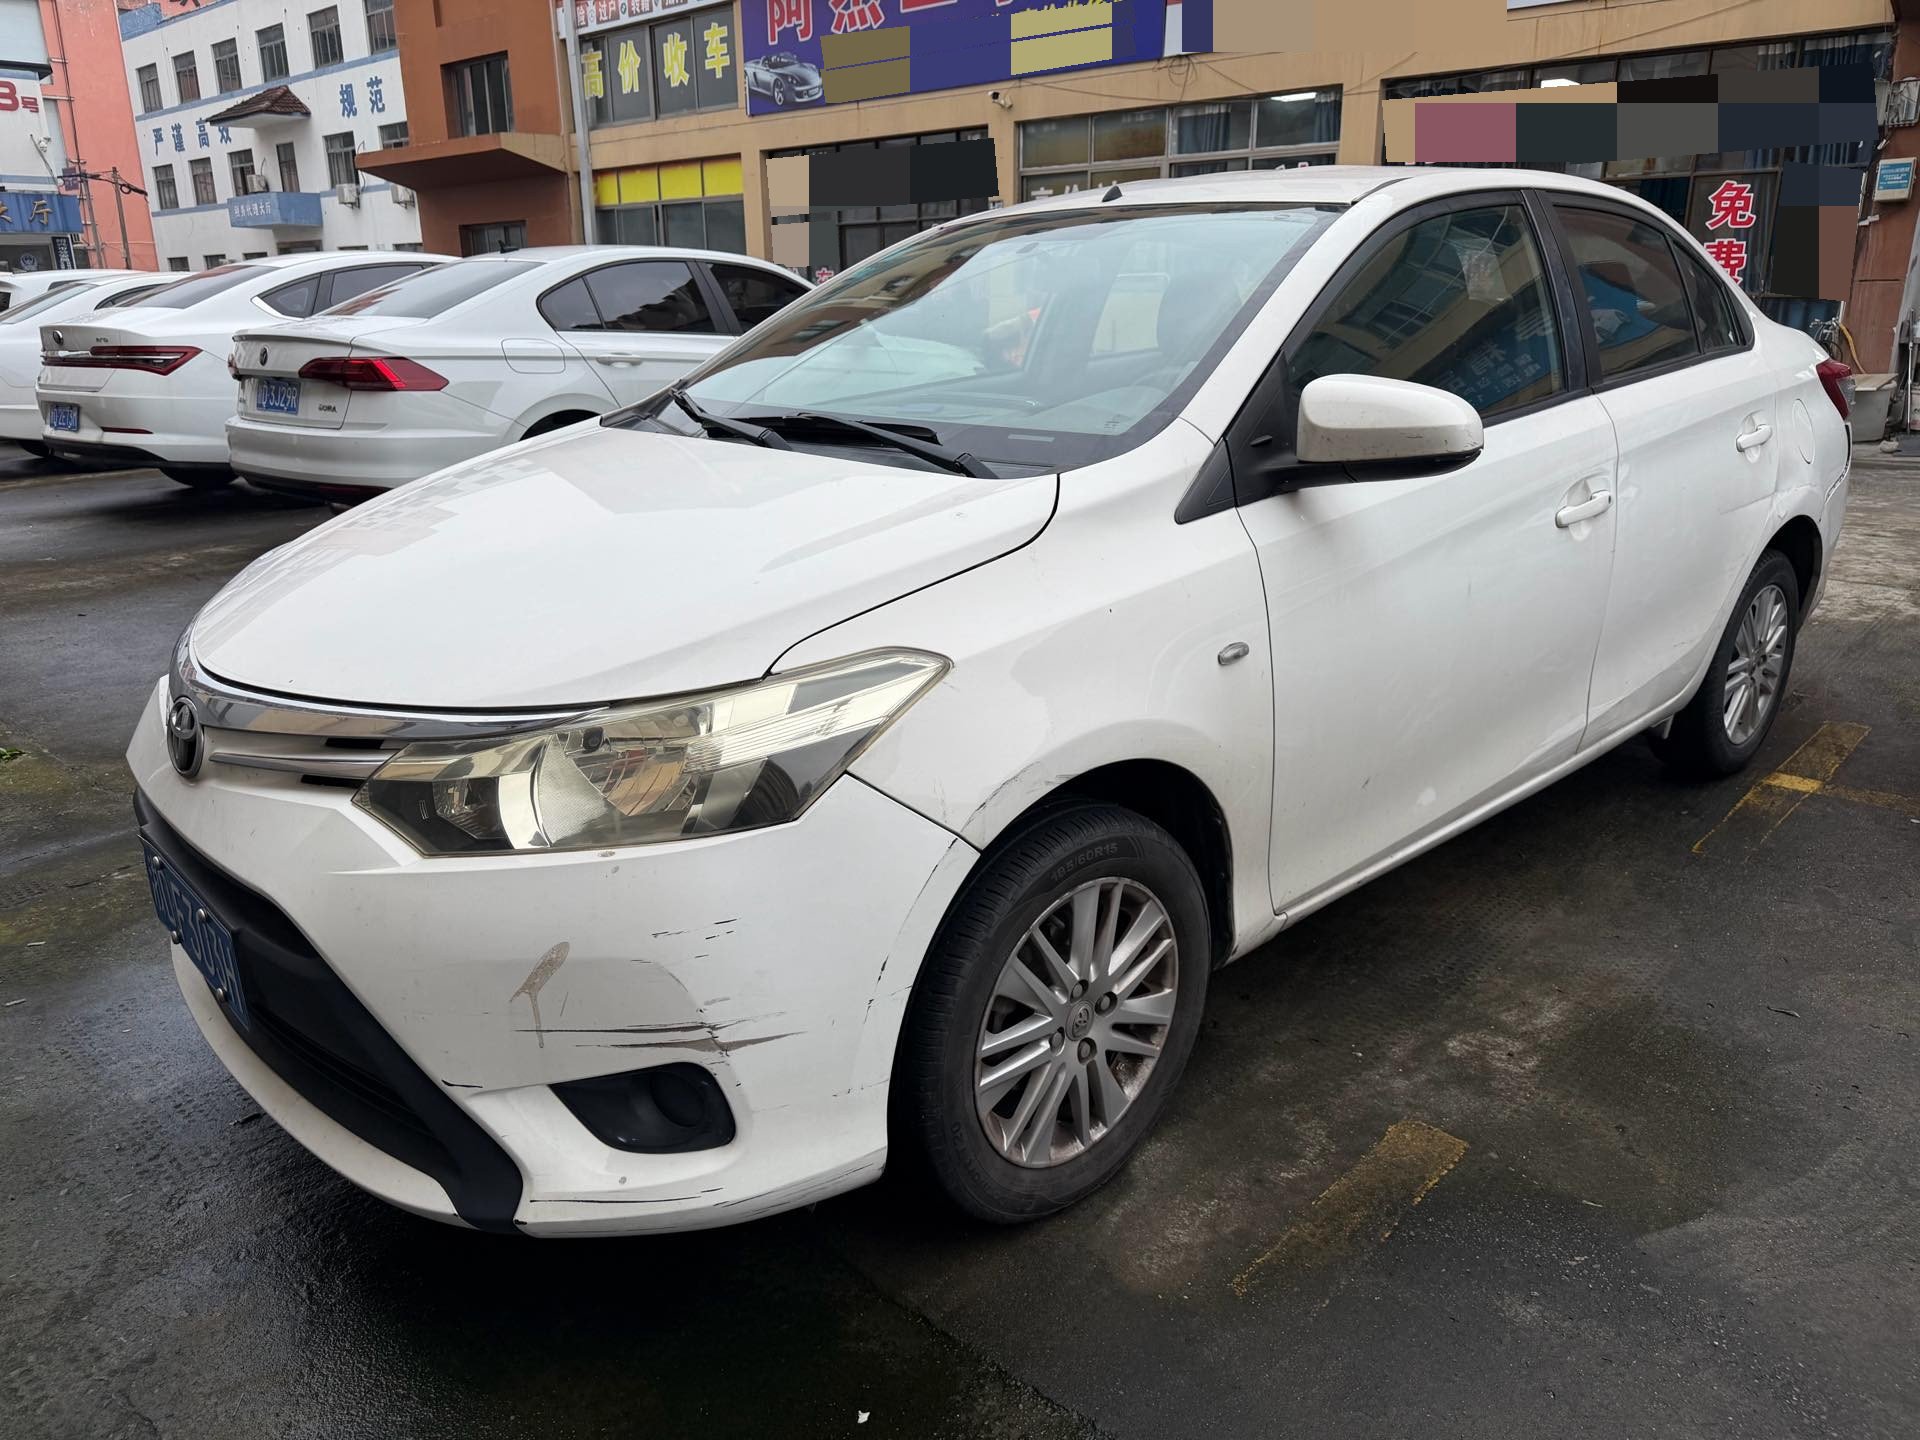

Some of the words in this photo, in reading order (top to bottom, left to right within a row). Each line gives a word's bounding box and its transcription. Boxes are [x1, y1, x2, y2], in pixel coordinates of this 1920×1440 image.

[598, 1, 617, 21] 过户
[581, 22, 730, 99] 高价收车
[339, 75, 386, 118] 规范
[1704, 180, 1756, 286] 免费
